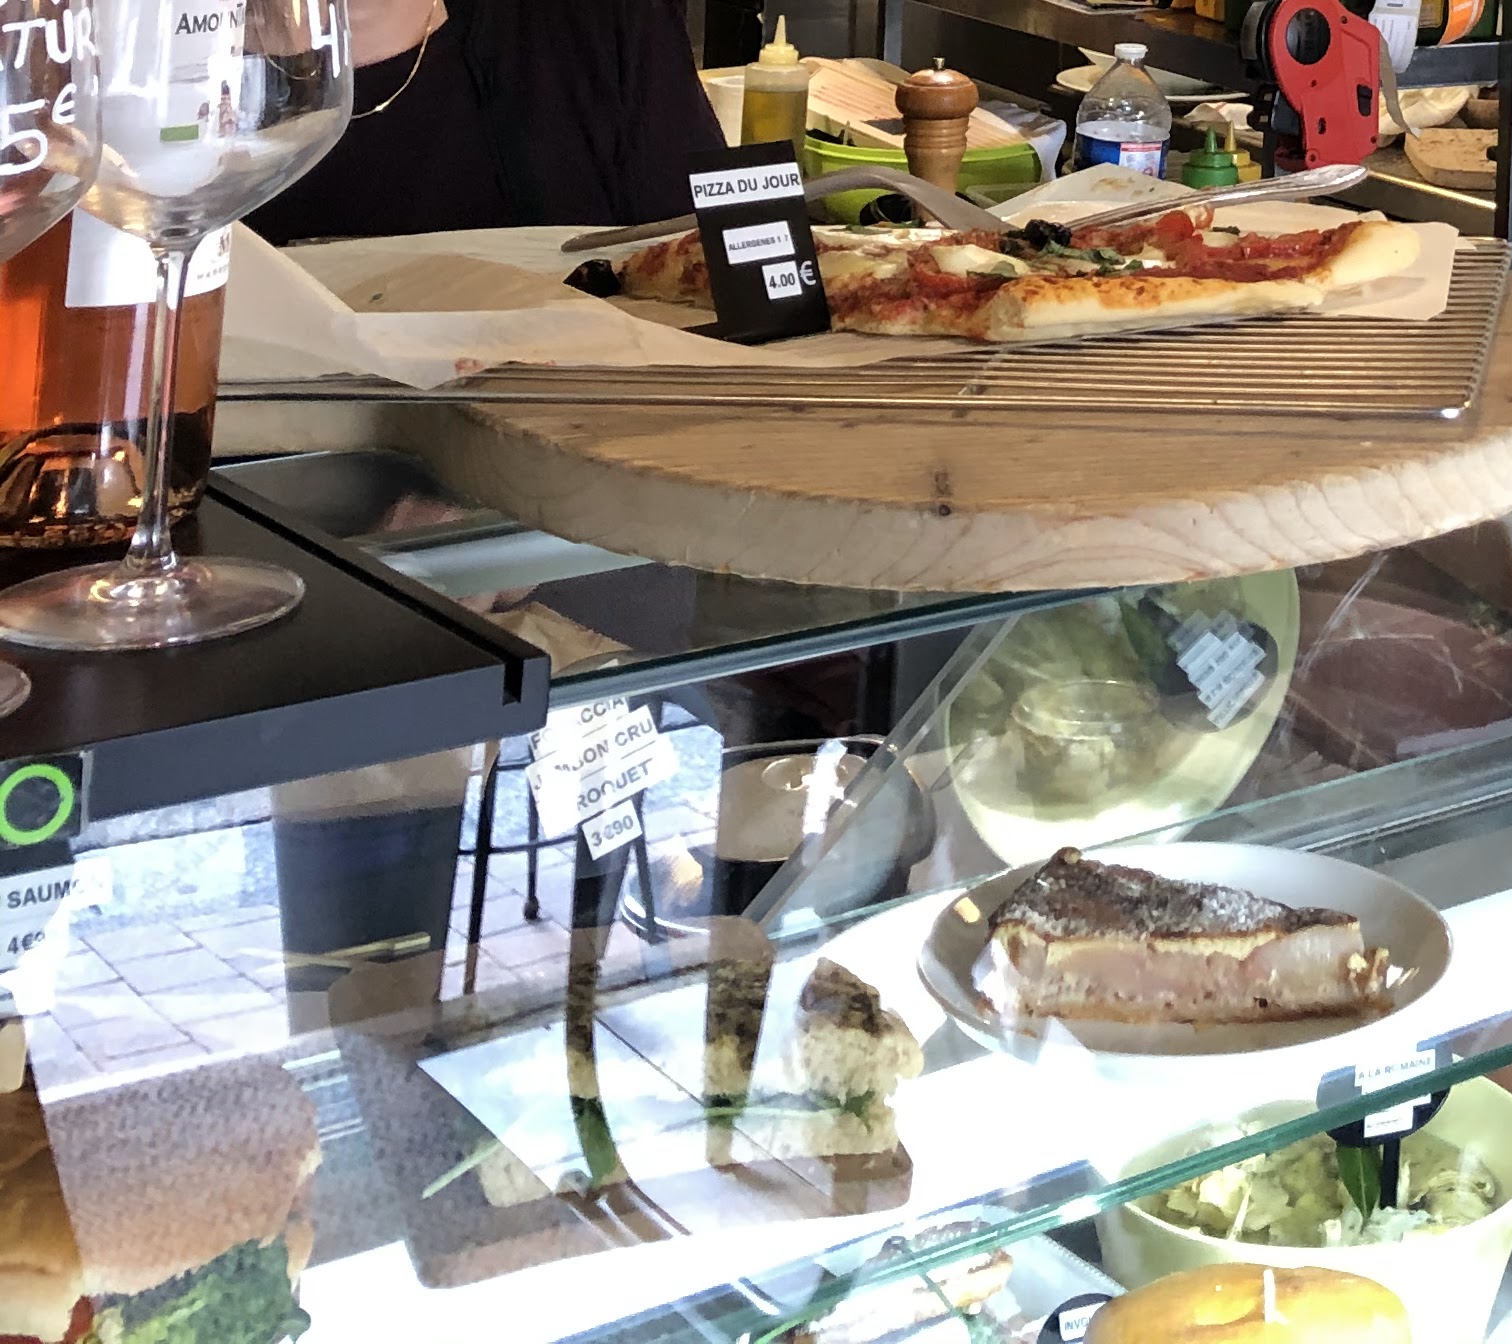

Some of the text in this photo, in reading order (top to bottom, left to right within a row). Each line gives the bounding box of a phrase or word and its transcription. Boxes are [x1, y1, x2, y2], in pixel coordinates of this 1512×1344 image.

[693, 172, 801, 199] PIZZA DU JOUR
[768, 272, 796, 289] 4.00
[614, 717, 653, 747] CRU
[7, 879, 80, 909] SAUM
